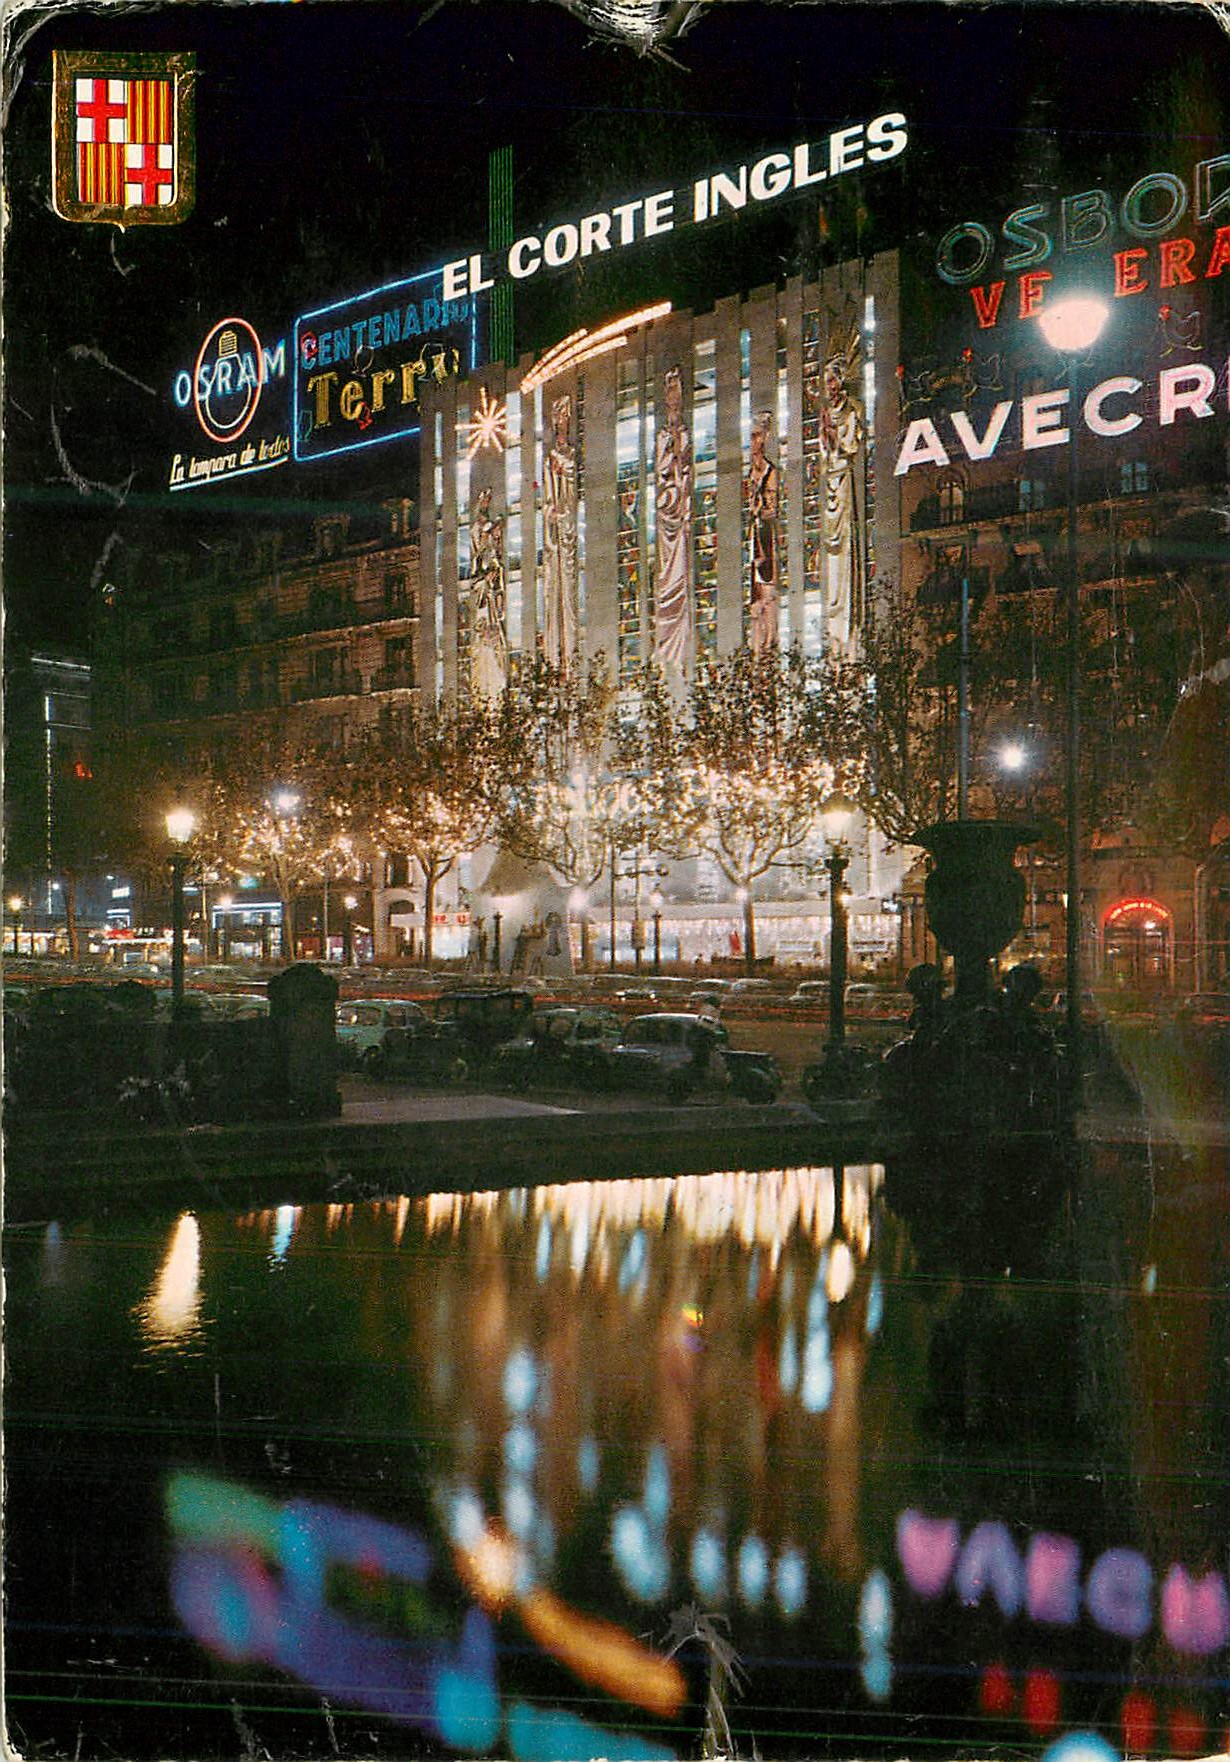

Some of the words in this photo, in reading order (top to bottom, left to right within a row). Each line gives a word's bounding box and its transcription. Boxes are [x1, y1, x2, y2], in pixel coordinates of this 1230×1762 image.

[443, 254, 495, 302] EL
[508, 190, 675, 280] CORTE
[694, 111, 909, 223] INGLES
[970, 225, 1230, 330] VEERA
[174, 337, 287, 408] OSRAM
[894, 363, 1230, 476] AVECR
[239, 442, 256, 466] de
